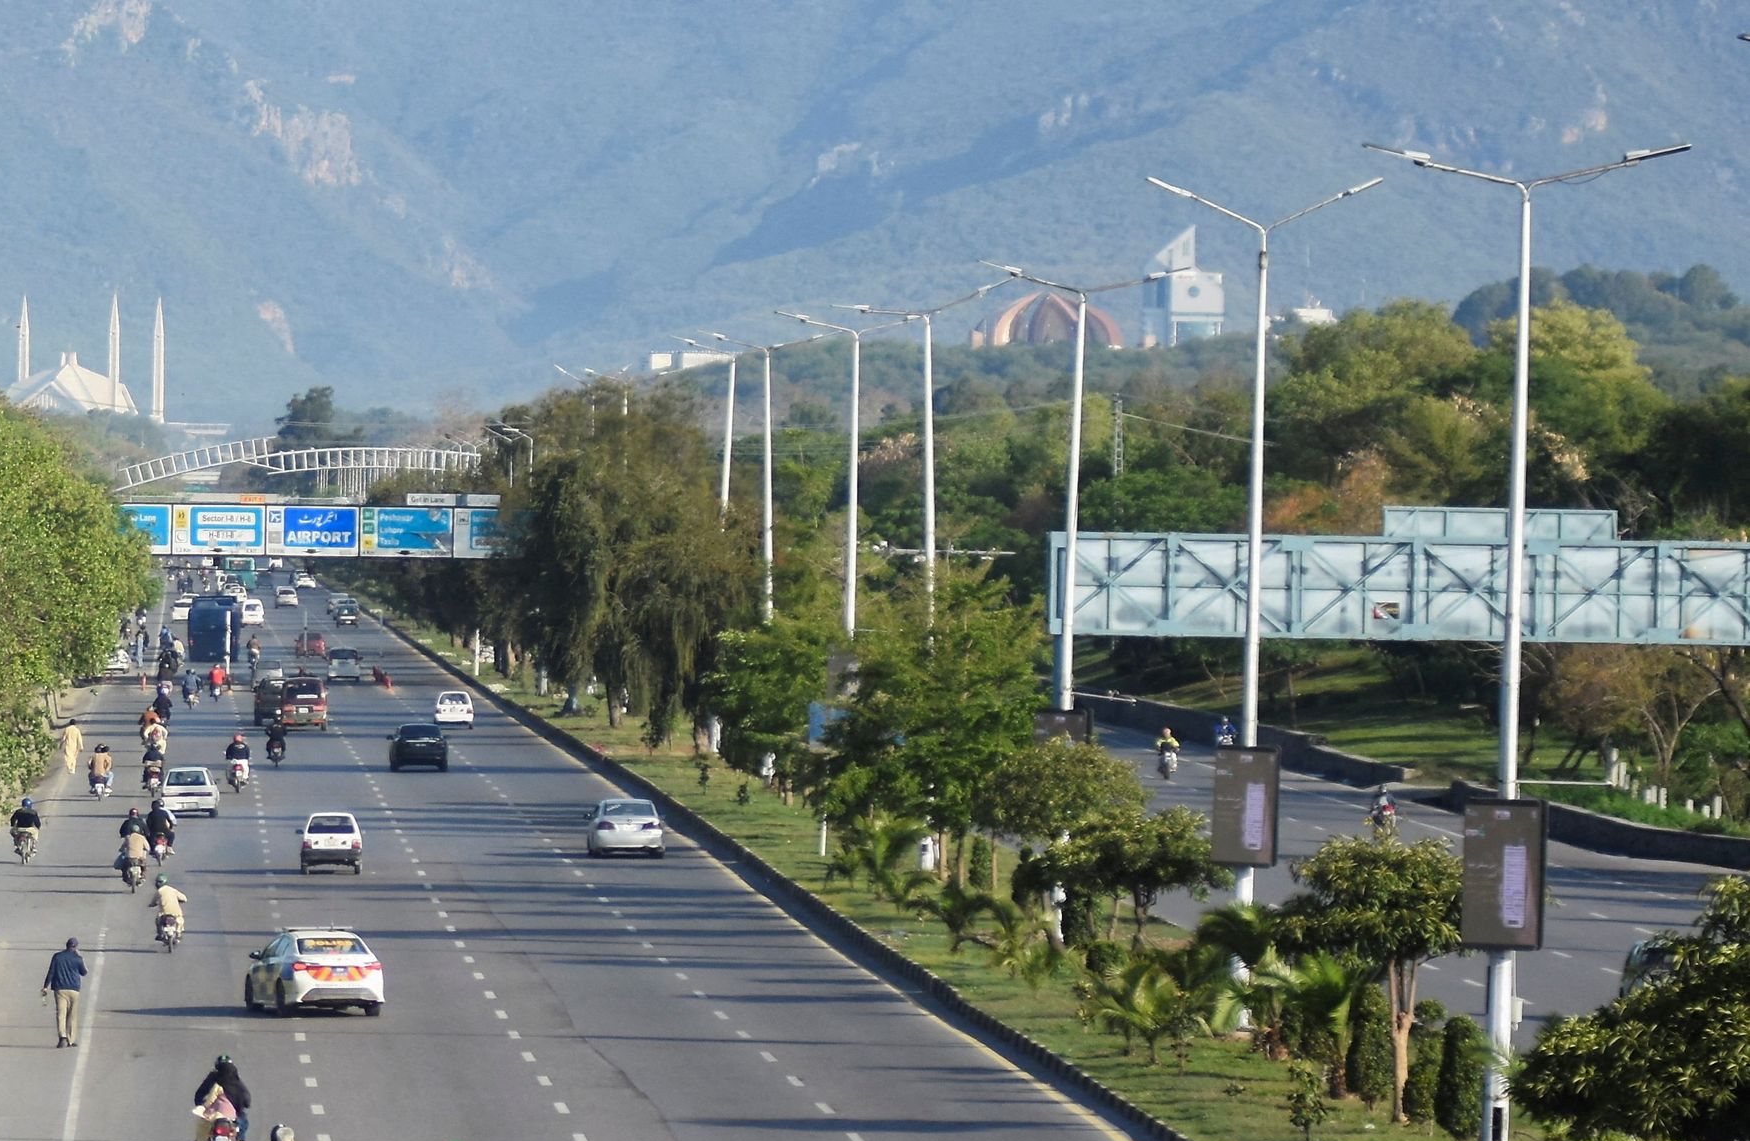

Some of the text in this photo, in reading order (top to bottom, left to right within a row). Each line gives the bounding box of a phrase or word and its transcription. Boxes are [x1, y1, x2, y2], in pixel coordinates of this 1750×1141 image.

[202, 514, 225, 522] Sector
[287, 531, 352, 544] AIRPORT
[306, 940, 352, 948] POLICE
